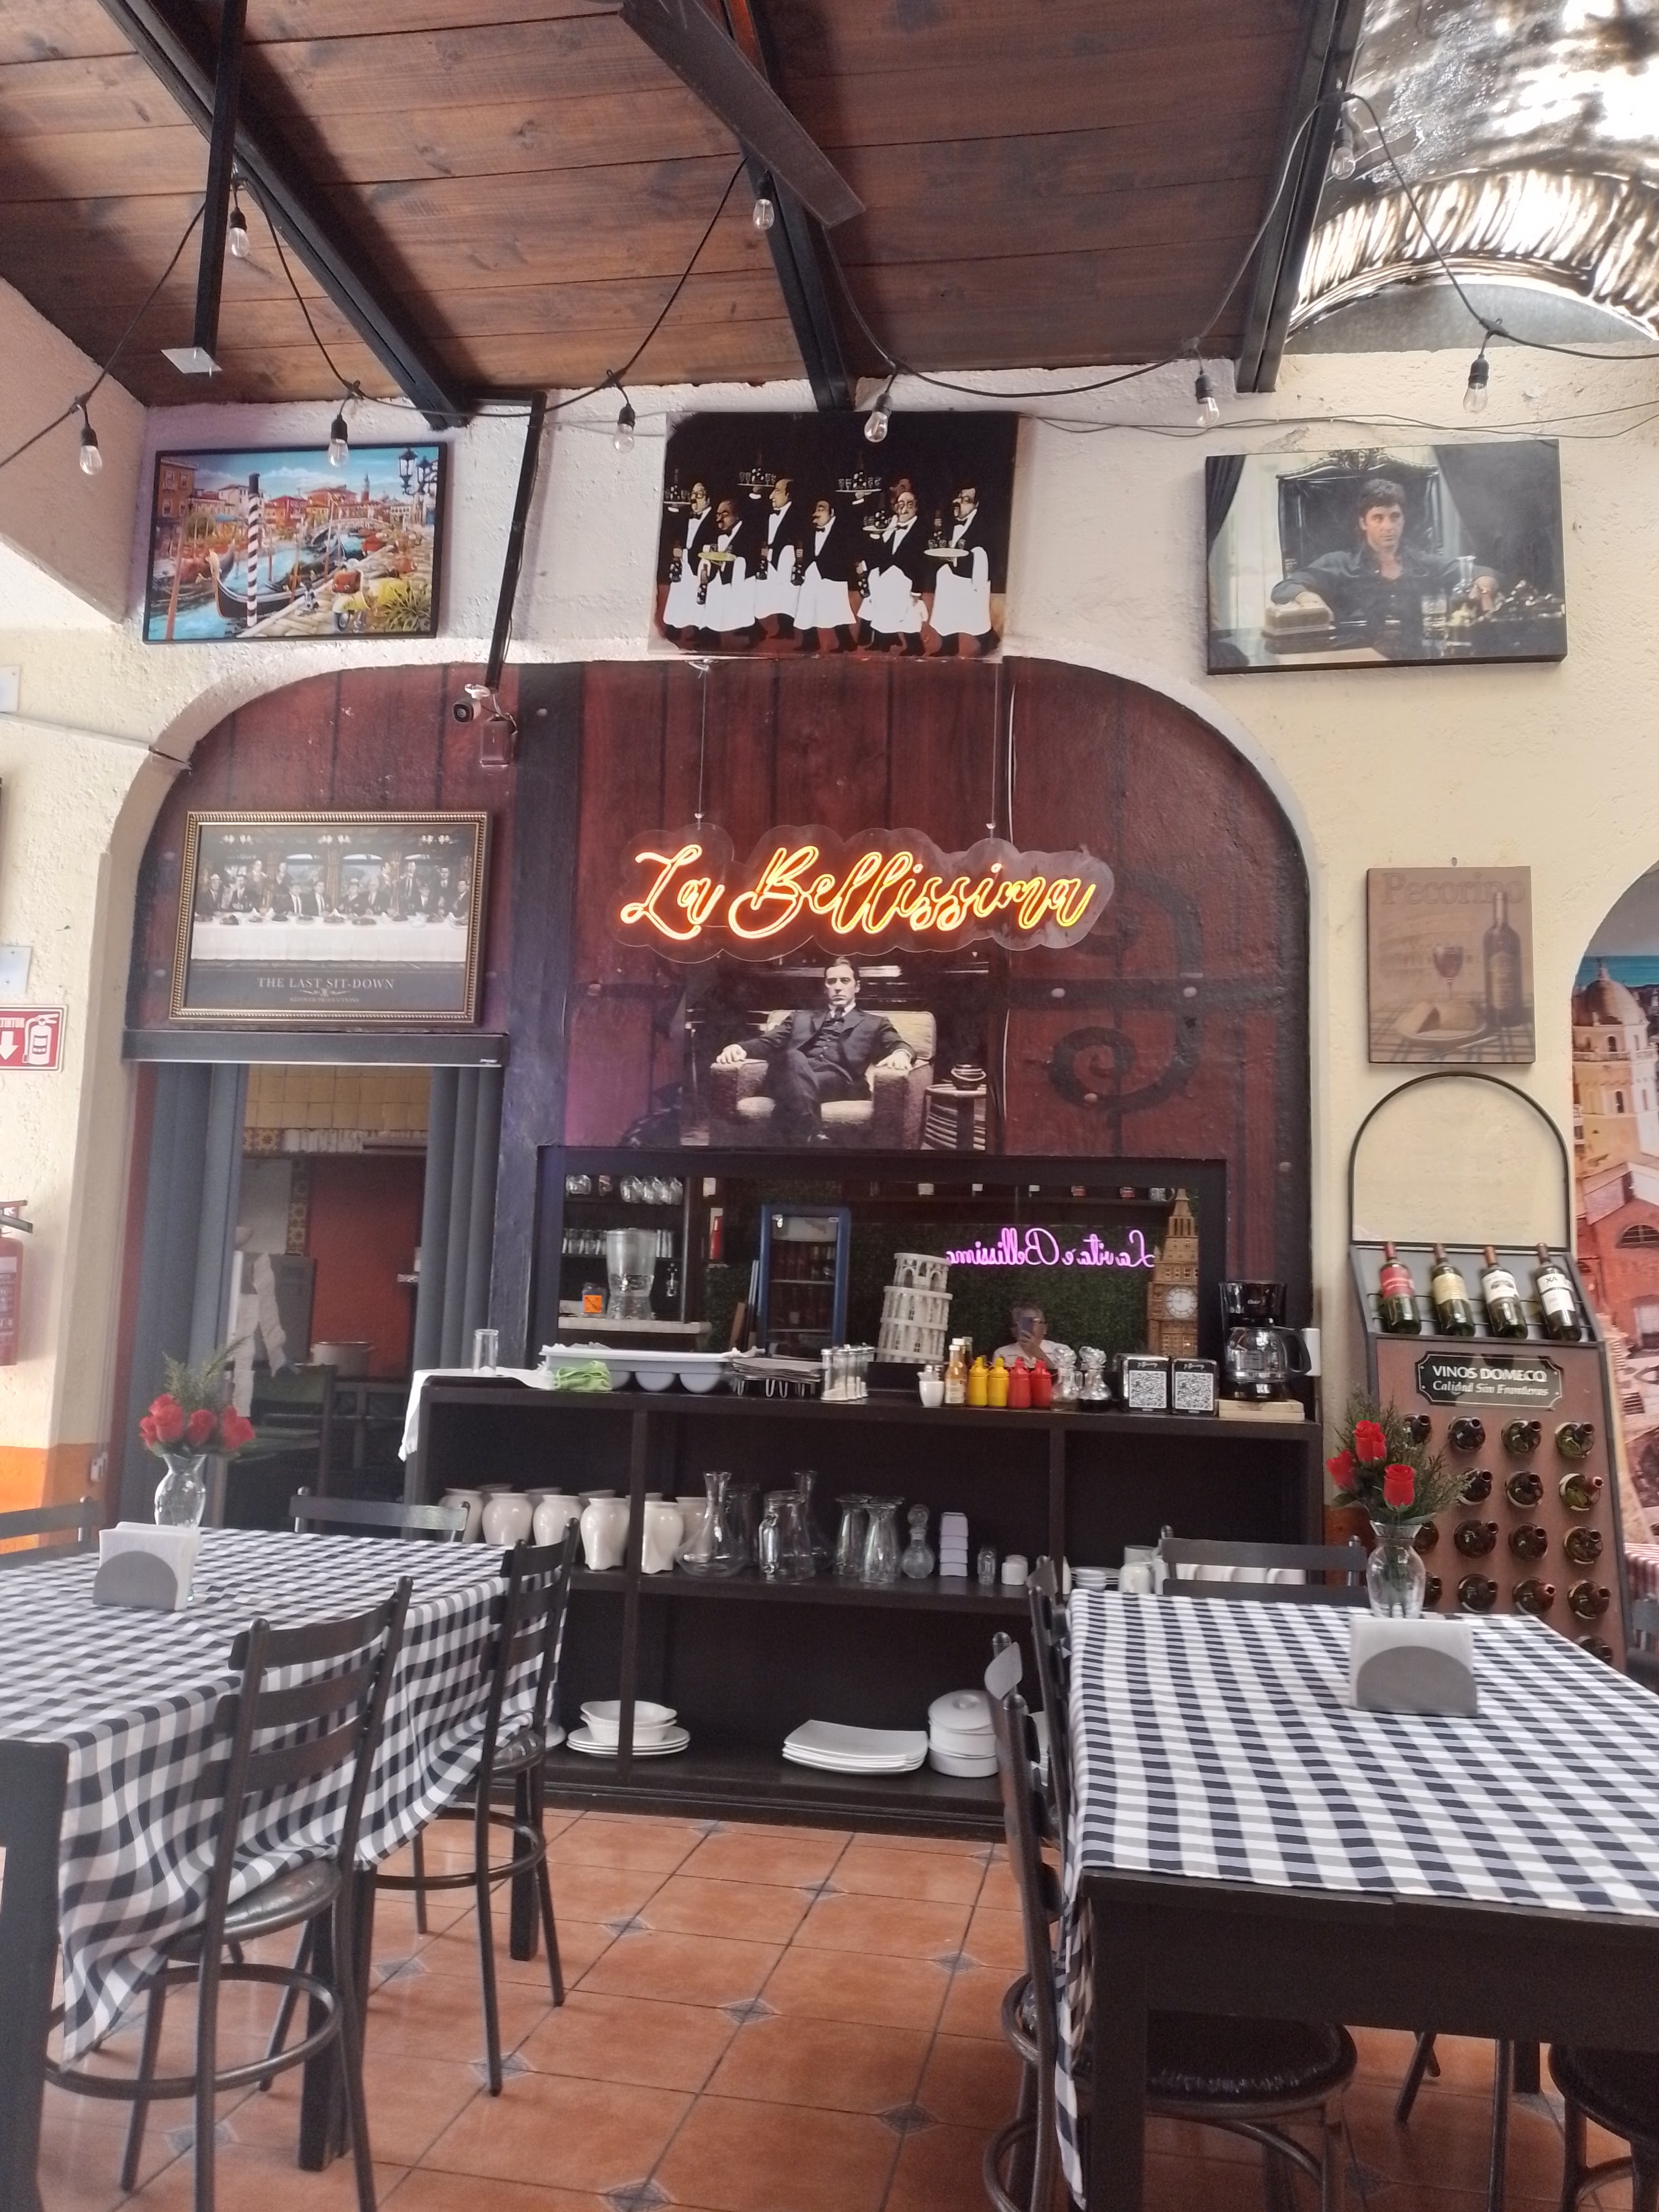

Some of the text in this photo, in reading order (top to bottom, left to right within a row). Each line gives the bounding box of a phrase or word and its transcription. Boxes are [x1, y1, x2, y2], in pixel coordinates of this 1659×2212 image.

[620, 843, 1097, 941] La Bellissima
[1382, 872, 1526, 905] Pecorino
[257, 977, 394, 989] THE LAST SIT-DOWN
[0, 1017, 25, 1029] TINTOR
[1432, 1365, 1478, 1379] VINOS
[1433, 1380, 1474, 1392] Calidad
